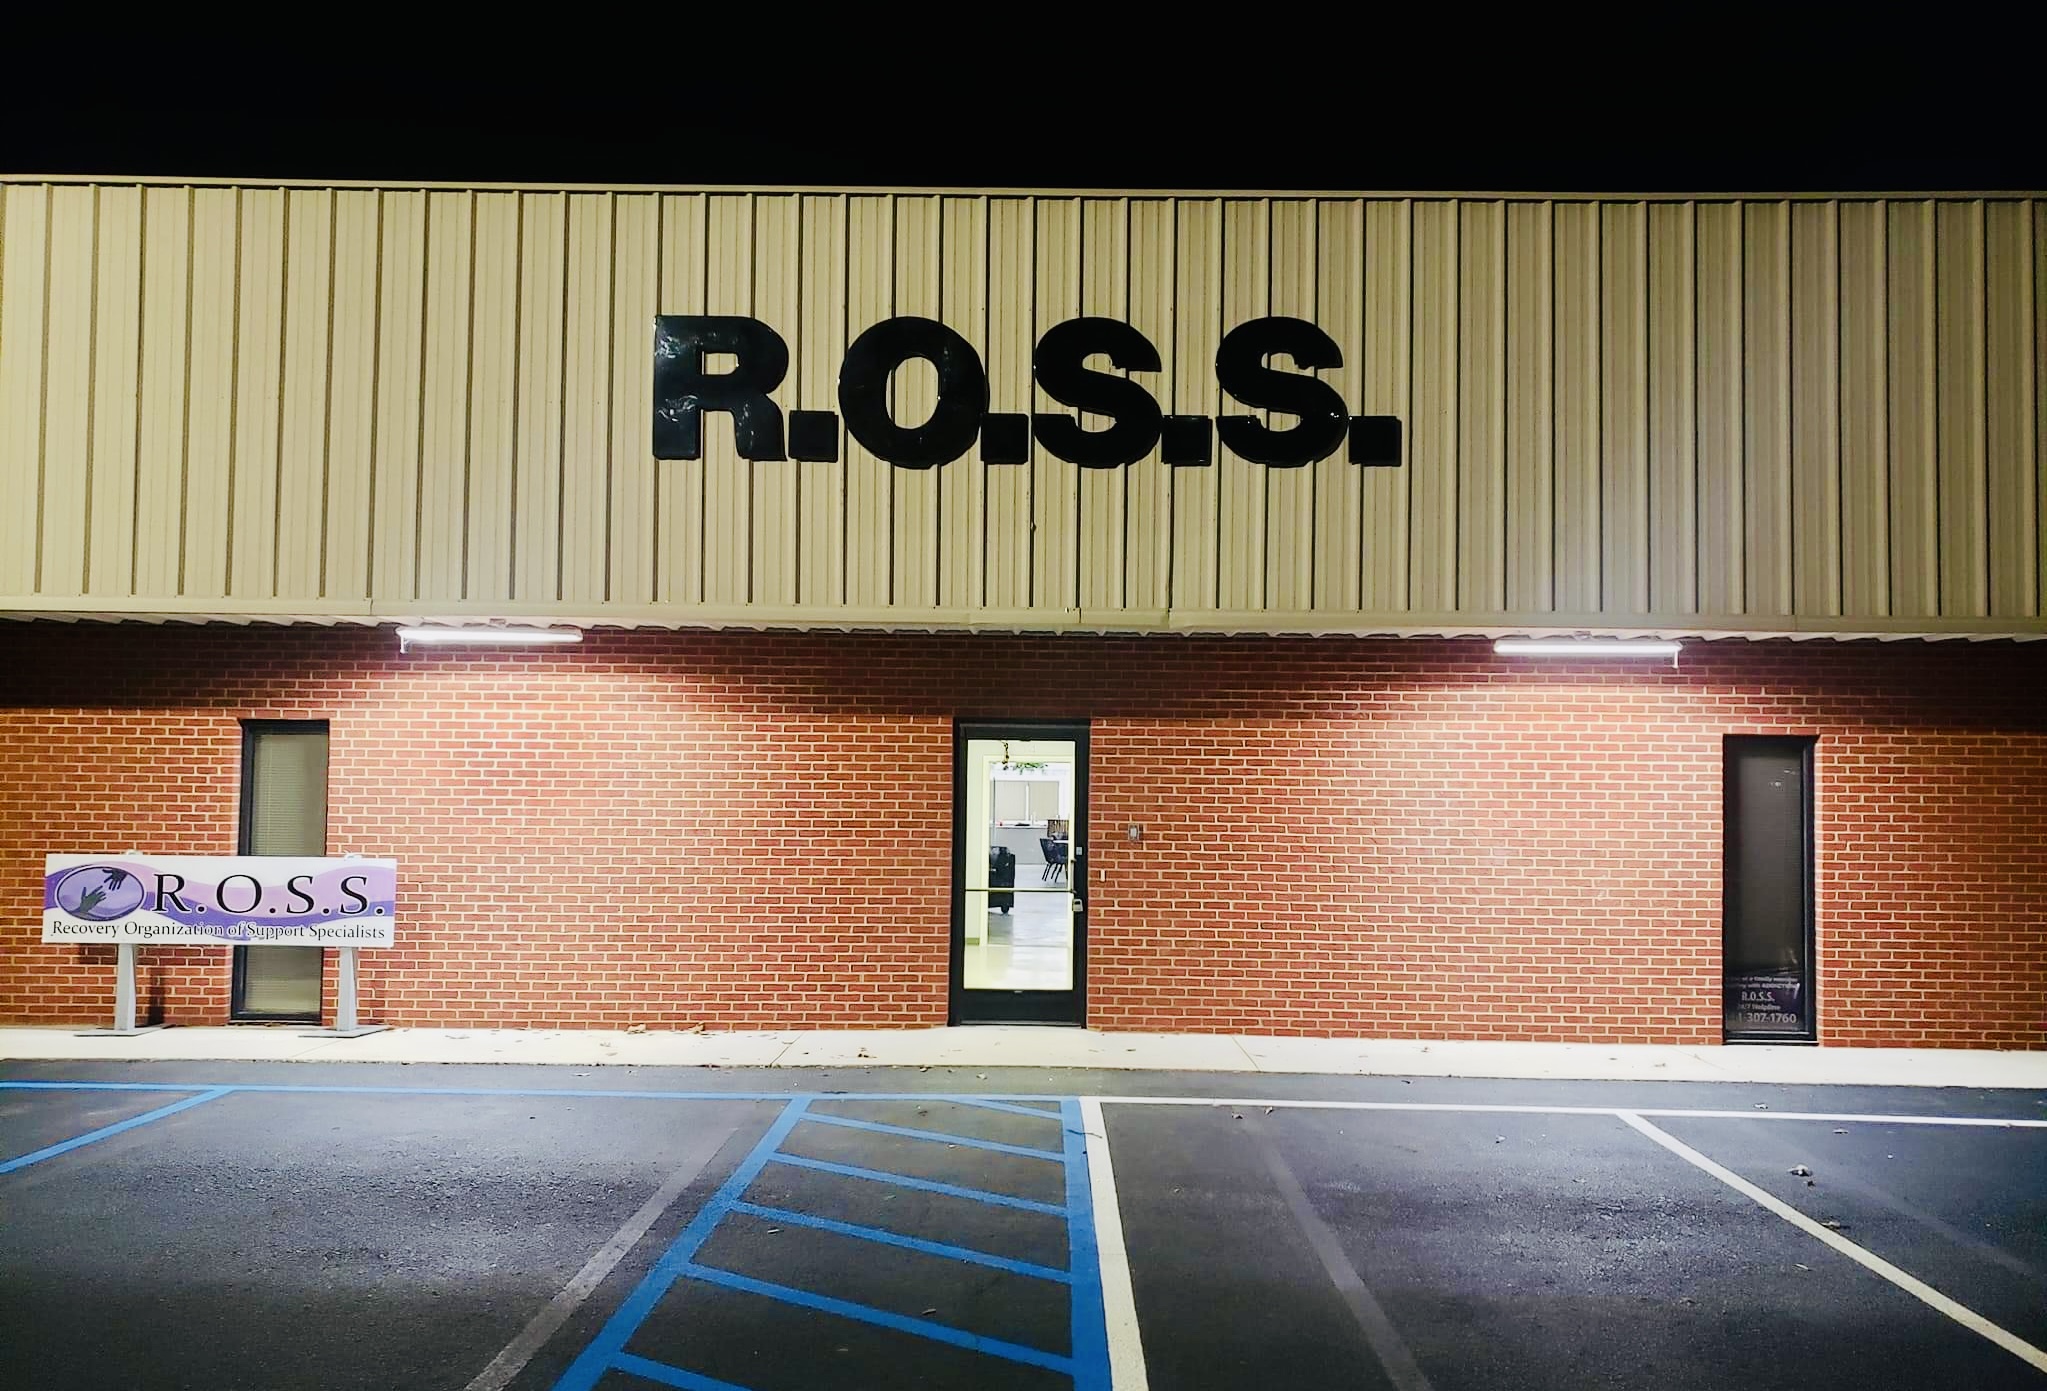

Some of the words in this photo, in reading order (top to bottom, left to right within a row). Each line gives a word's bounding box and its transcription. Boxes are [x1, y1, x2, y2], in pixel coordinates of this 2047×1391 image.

[653, 315, 1401, 469] R.O.S.S.
[152, 873, 384, 914] R.O.S.S.
[52, 920, 118, 938] Recovery
[124, 921, 223, 939] Organization
[227, 920, 244, 936] of
[246, 921, 304, 939] Support
[308, 924, 385, 941] Specialists
